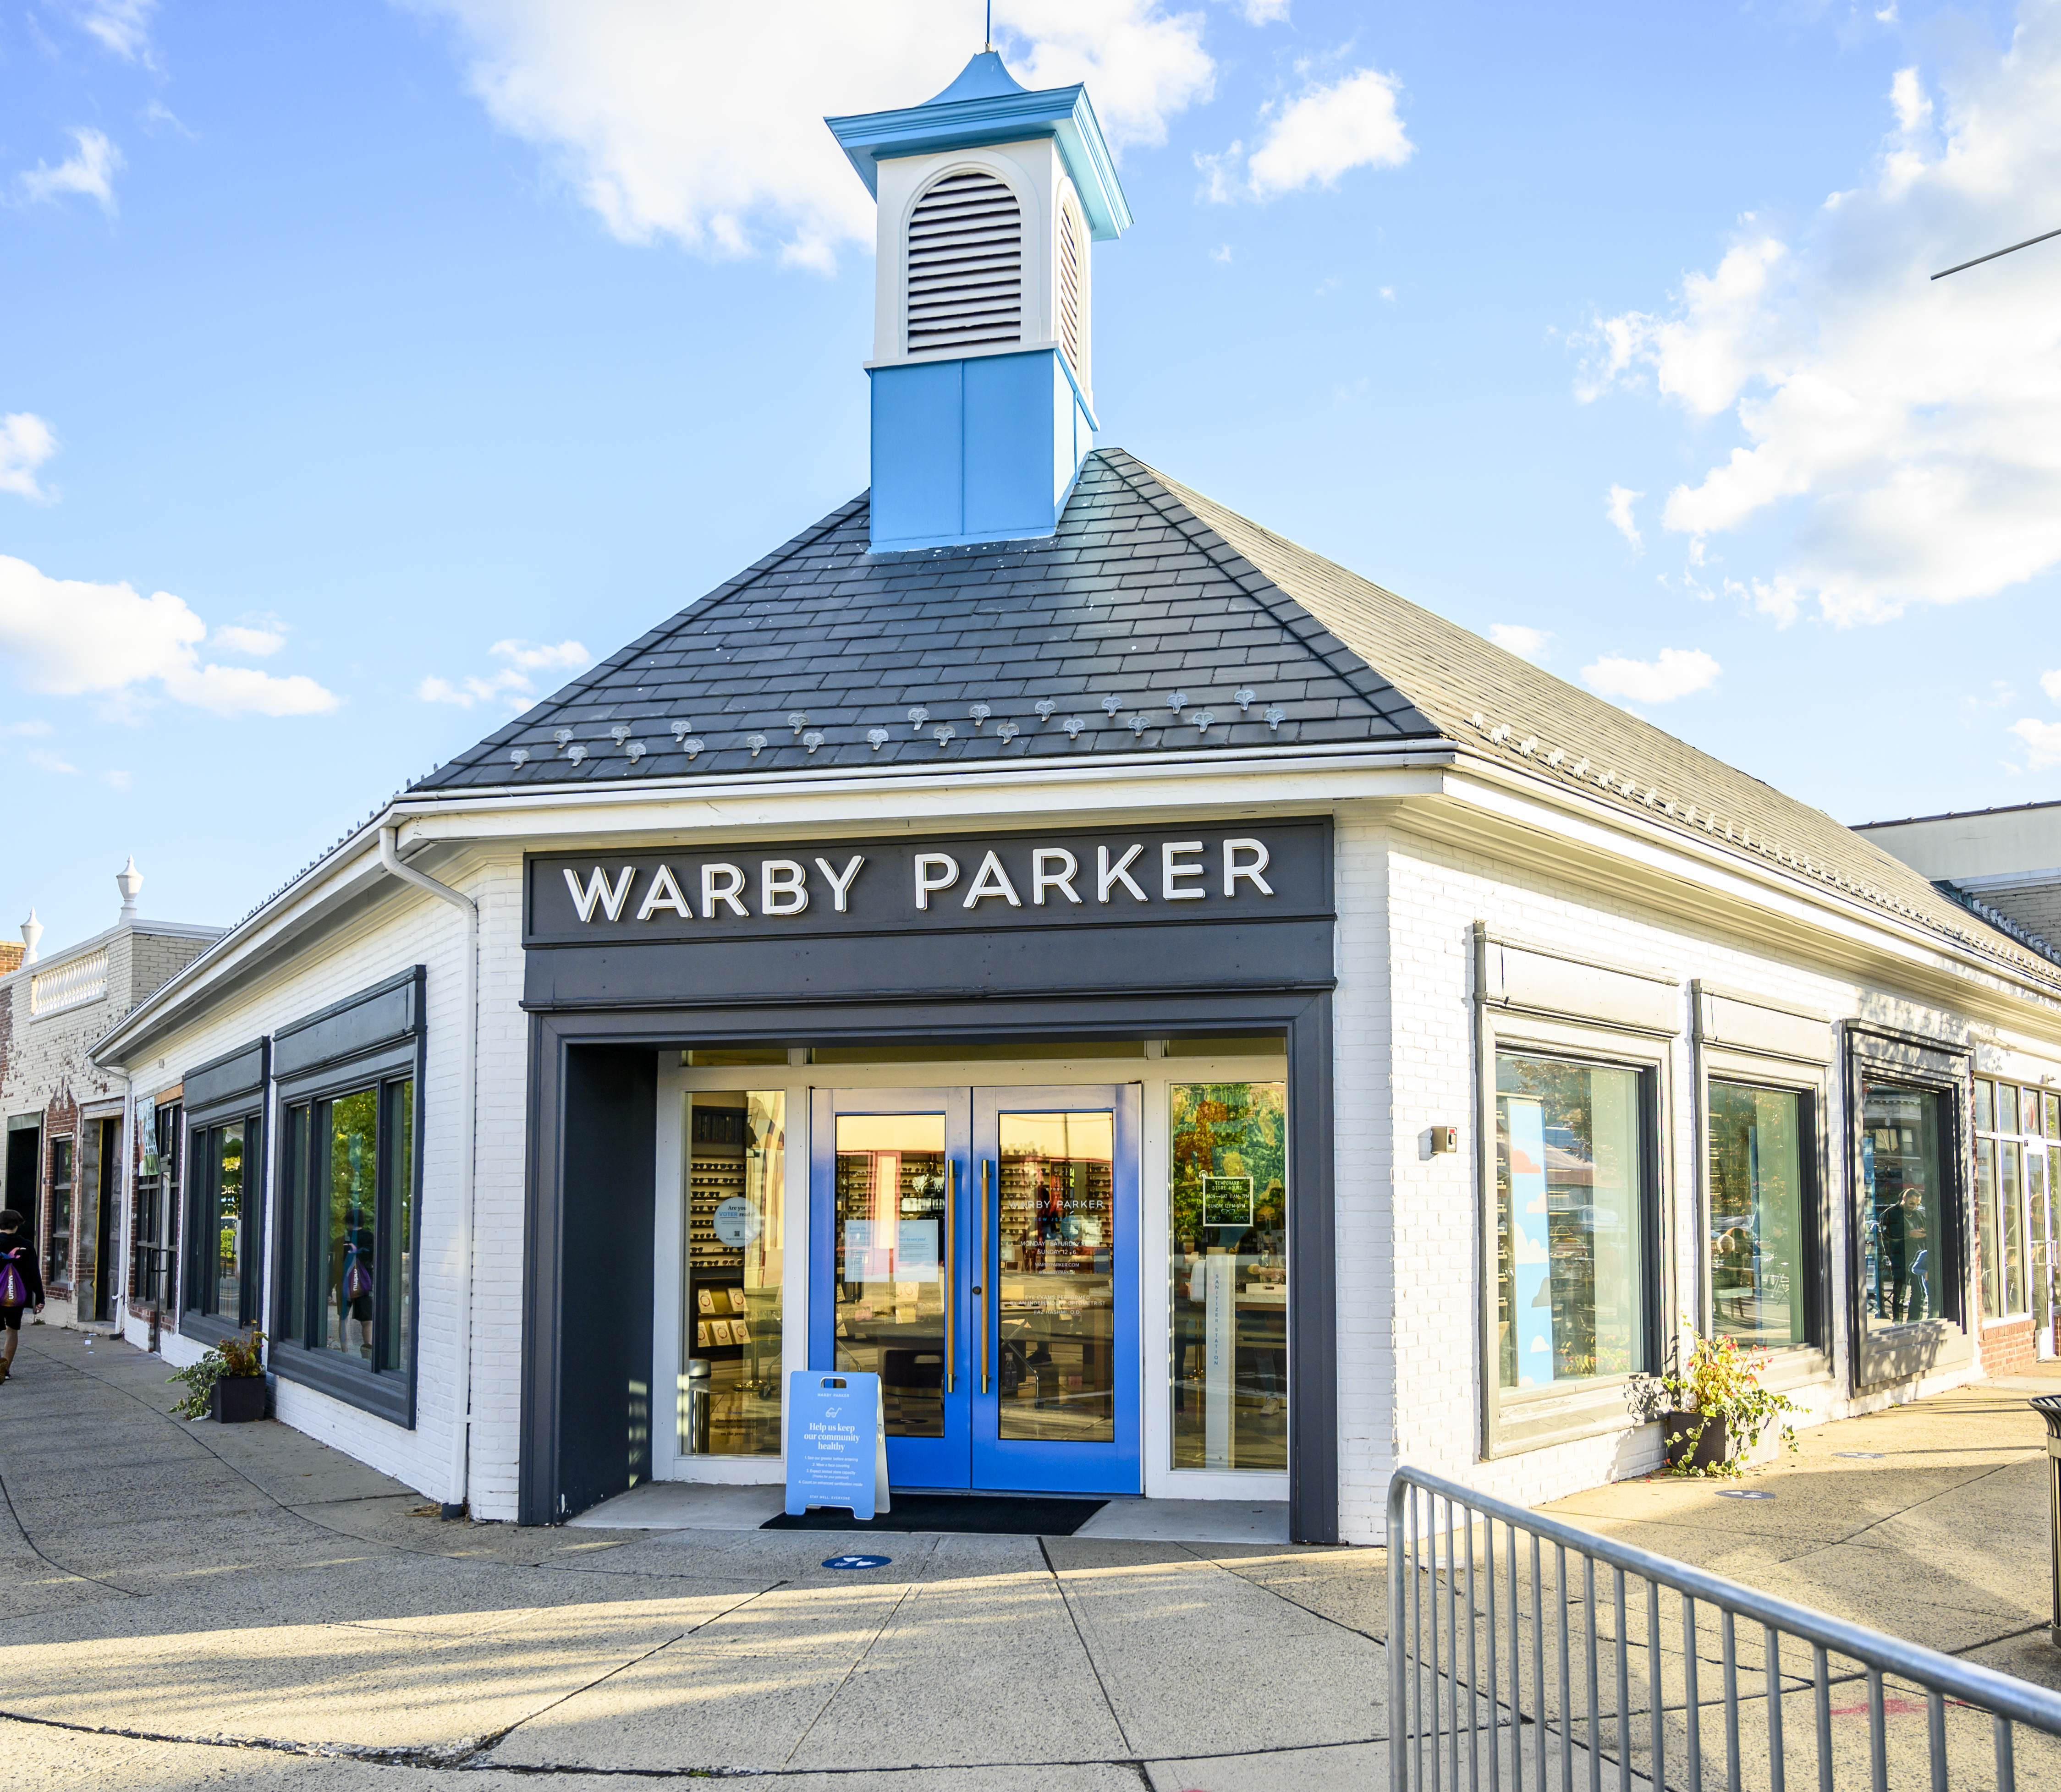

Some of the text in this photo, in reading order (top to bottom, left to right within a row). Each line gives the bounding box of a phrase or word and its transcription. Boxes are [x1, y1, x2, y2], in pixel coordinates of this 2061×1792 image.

[563, 838, 1274, 923] WARBY PARKER
[1008, 1200, 1103, 1209] WARBY PARKER
[809, 1423, 826, 1433] Help
[837, 1423, 855, 1434] keep
[818, 1434, 860, 1444] community
[818, 1441, 845, 1452] healthy
